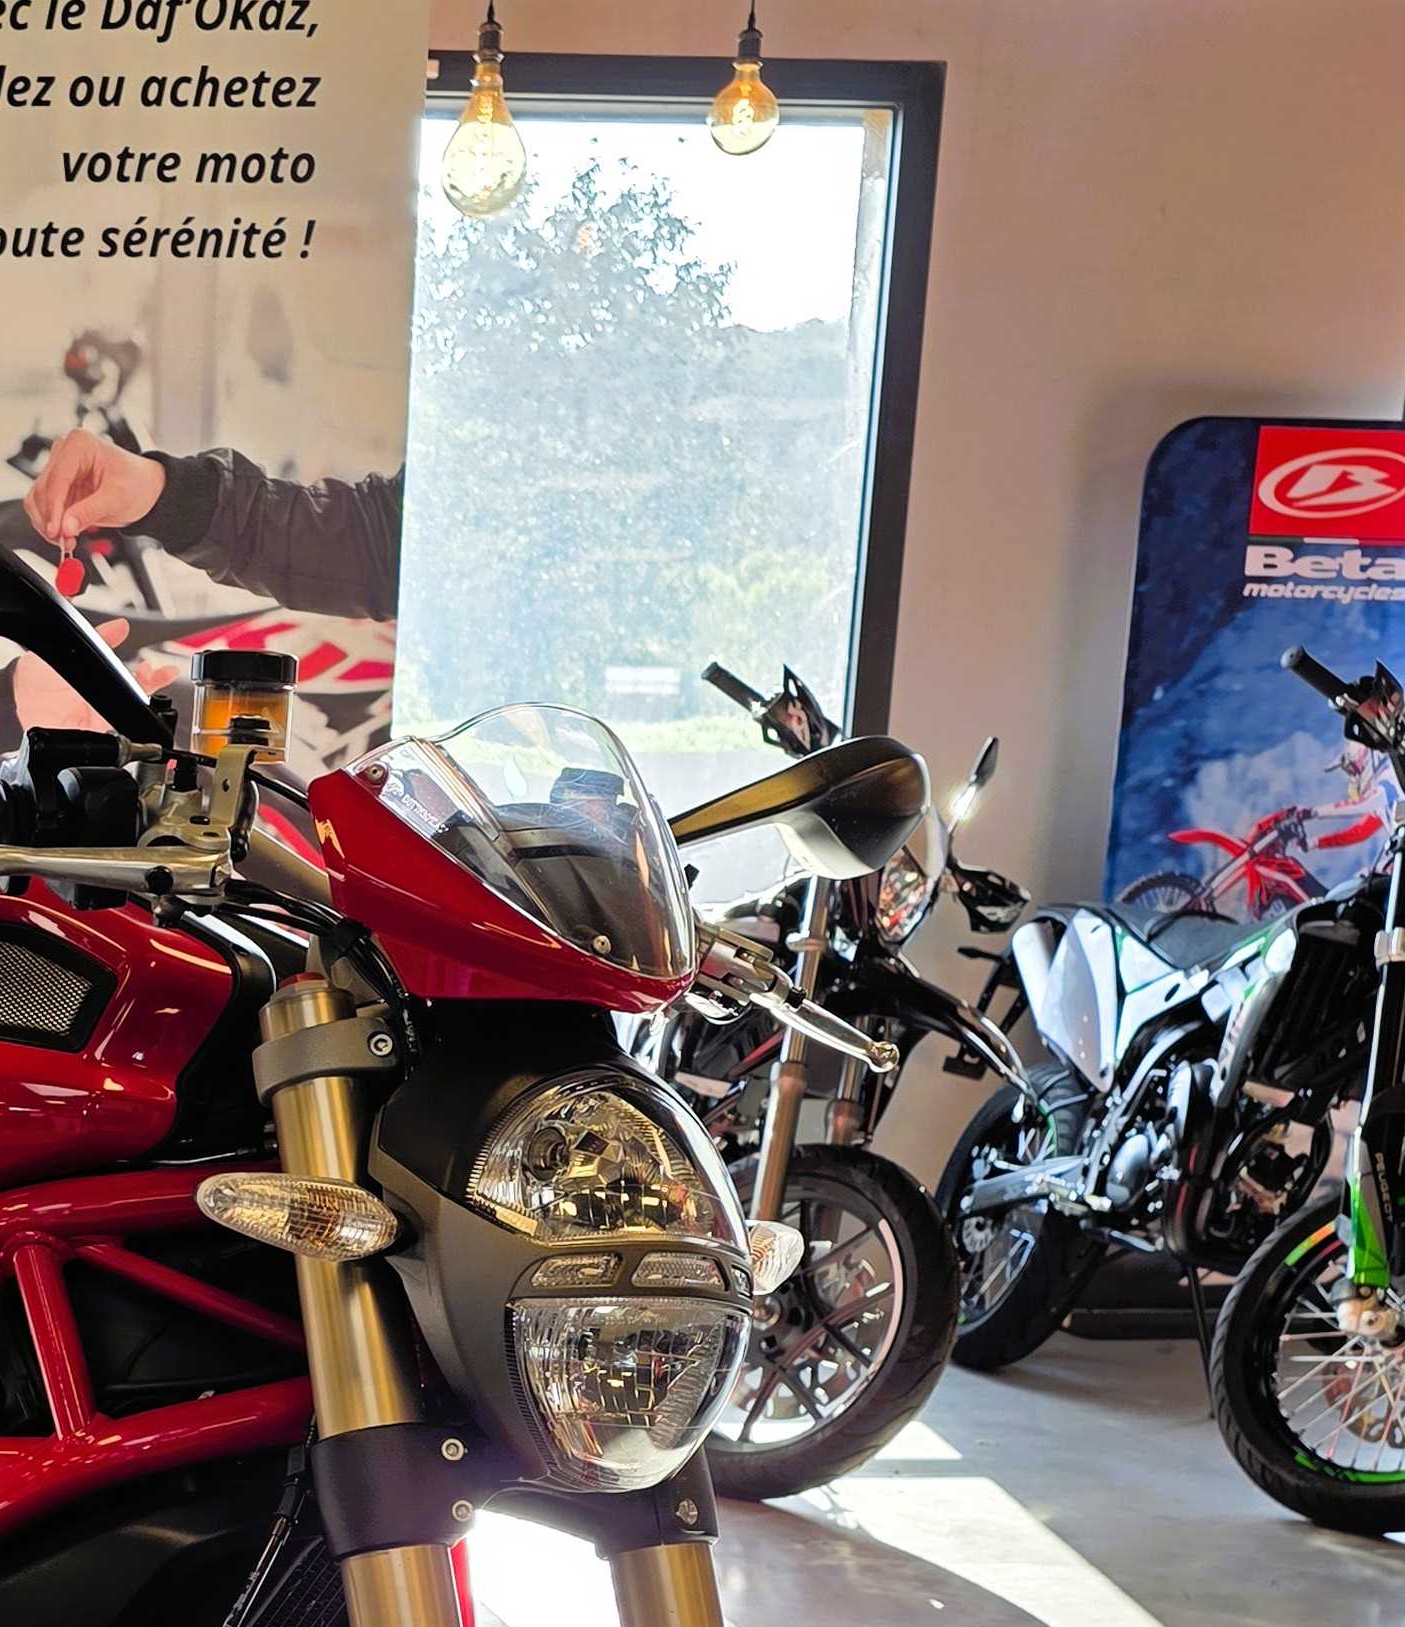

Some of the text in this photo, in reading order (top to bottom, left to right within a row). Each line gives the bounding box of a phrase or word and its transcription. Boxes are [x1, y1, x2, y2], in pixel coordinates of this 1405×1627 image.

[45, 0, 86, 31] le
[69, 75, 125, 108] ou
[140, 66, 322, 108] achetez
[62, 146, 316, 184] votre moto
[98, 216, 286, 259] sérénité
[299, 219, 316, 259] !
[1244, 545, 1405, 580] Beta
